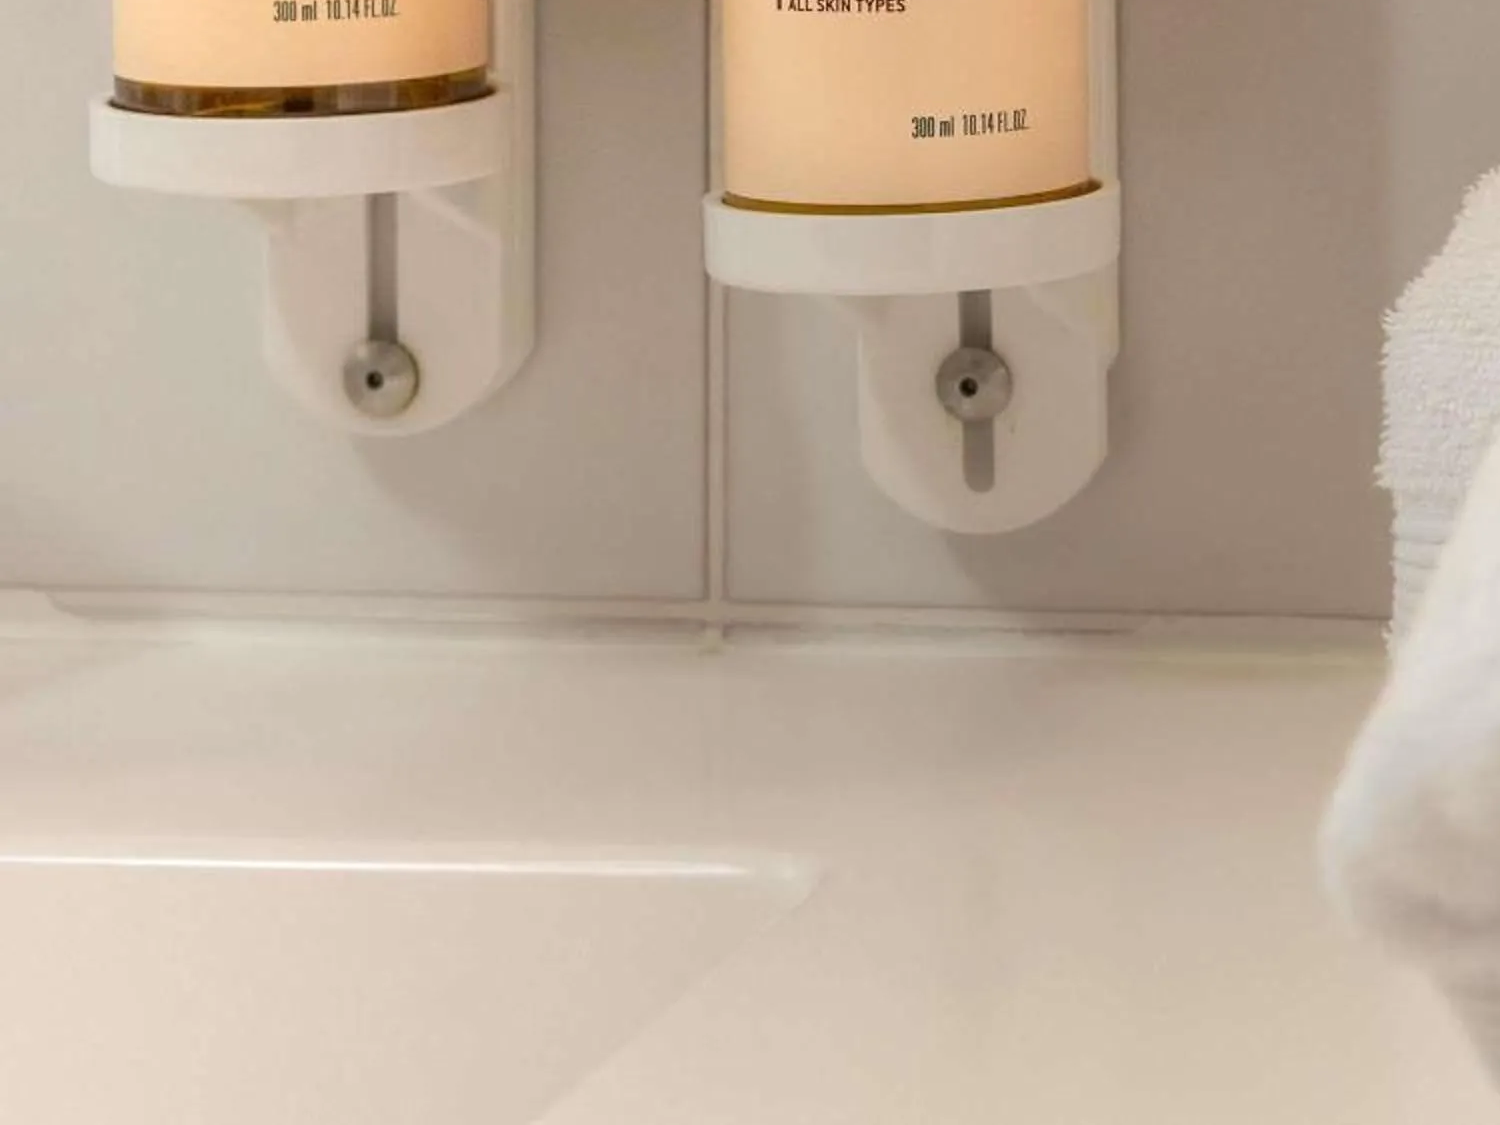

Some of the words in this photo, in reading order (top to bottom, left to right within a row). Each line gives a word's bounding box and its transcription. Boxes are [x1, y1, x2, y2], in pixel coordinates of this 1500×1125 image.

[273, 0, 297, 21] 300
[301, 0, 317, 21] ml
[911, 117, 935, 139] 300
[939, 116, 954, 137] ml
[962, 112, 994, 136] 10.14
